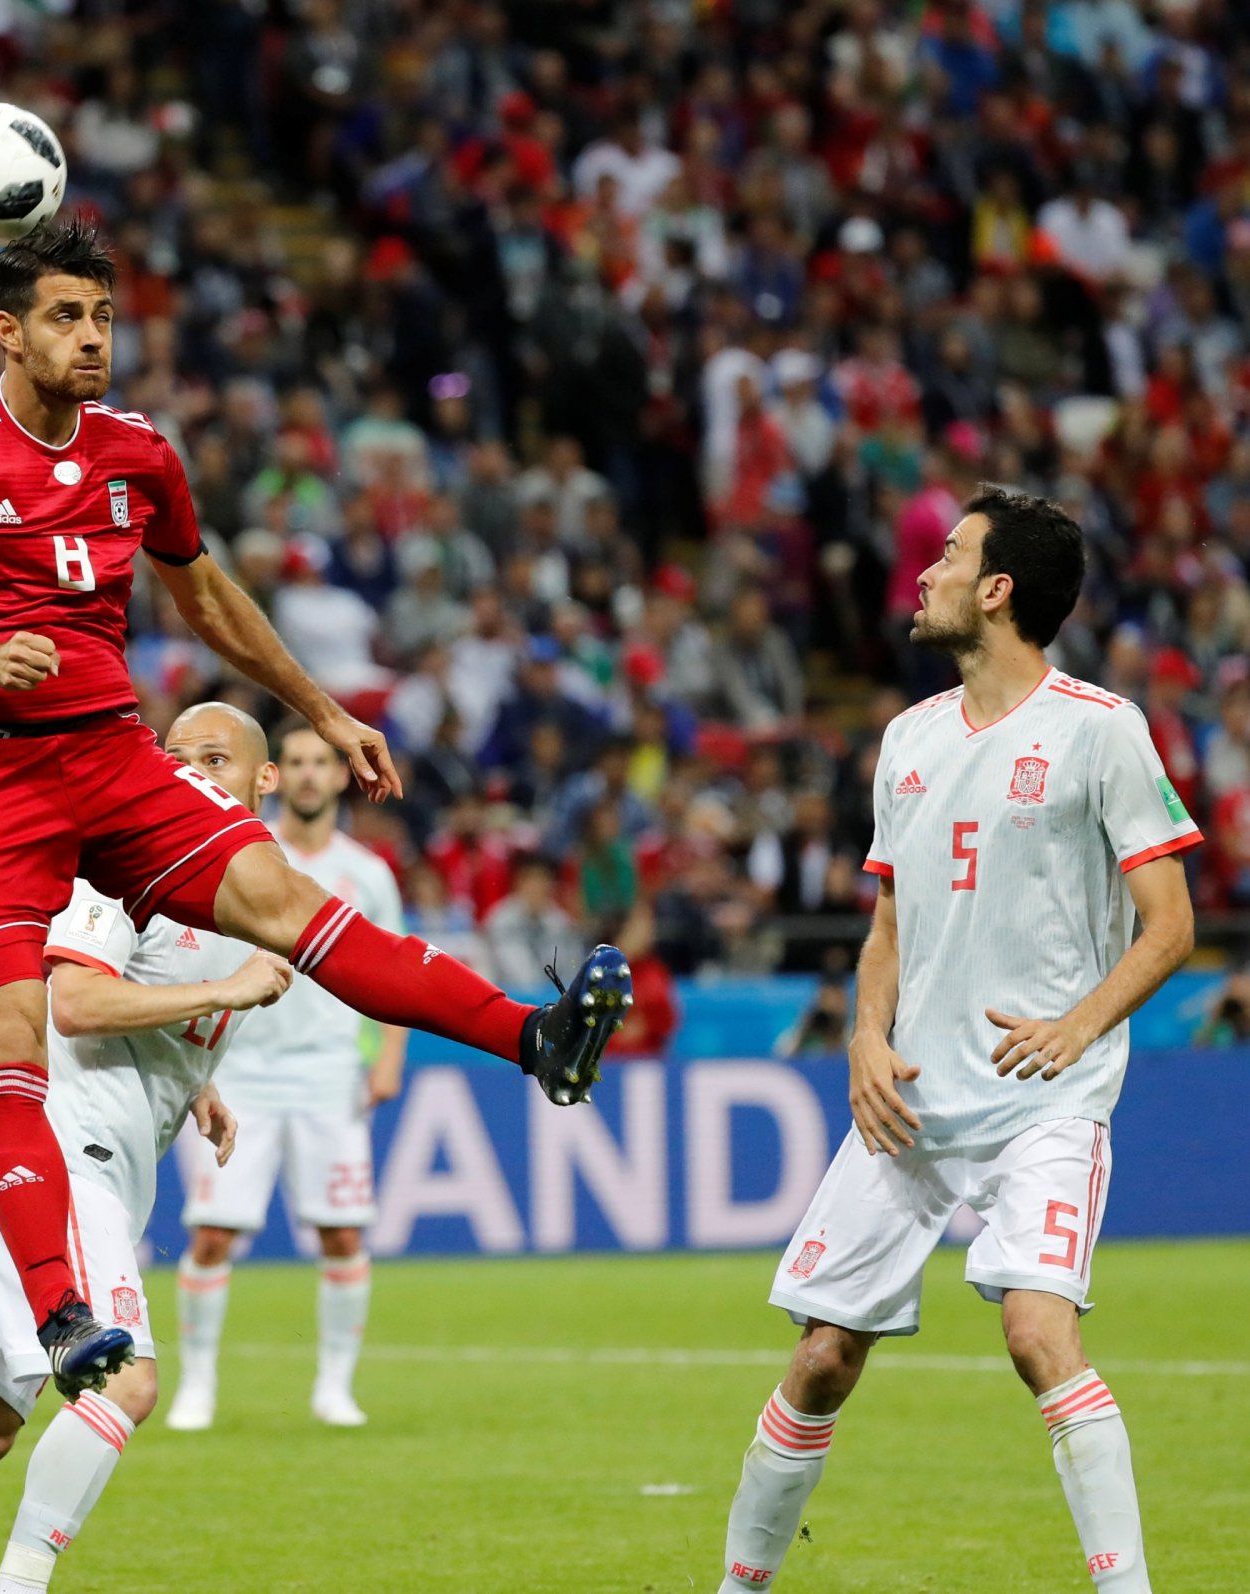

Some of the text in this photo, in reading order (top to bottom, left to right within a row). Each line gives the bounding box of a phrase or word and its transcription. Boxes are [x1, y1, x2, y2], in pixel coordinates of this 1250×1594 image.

[52, 535, 96, 592] 8
[173, 765, 244, 812] 8
[895, 784, 927, 795] adidas
[951, 821, 979, 891] 5
[175, 940, 201, 951] adidas
[1038, 1199, 1079, 1271] 5
